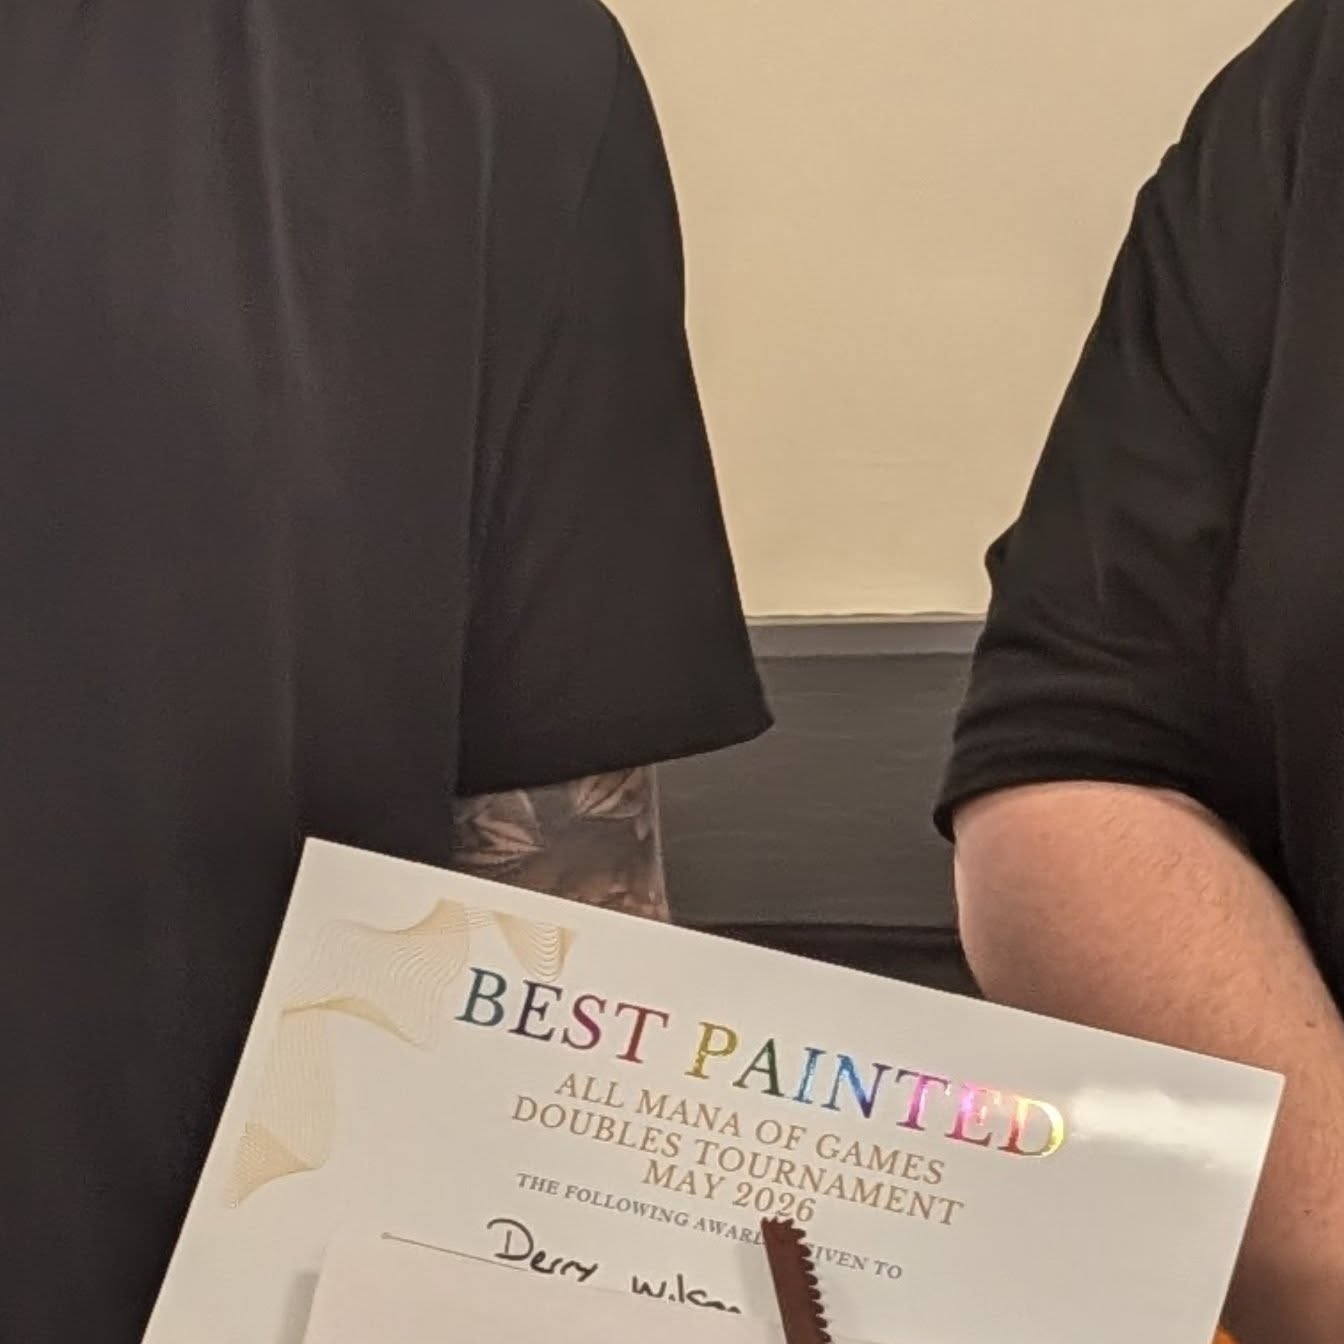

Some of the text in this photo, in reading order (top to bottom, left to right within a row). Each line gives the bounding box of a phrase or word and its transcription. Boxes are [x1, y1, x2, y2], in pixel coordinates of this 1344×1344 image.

[455, 966, 1065, 1158] BEST PAINTED
[512, 1095, 965, 1226] DOUBLES TOURNAMENT
[555, 1073, 946, 1185] ALL MANA OF GAMES
[516, 1172, 561, 1196] THE
[564, 1184, 690, 1228] FOLLOWING
[806, 1242, 869, 1271] IVEN
[873, 1260, 904, 1280] TO
[642, 1158, 817, 1223] MAY 2026
